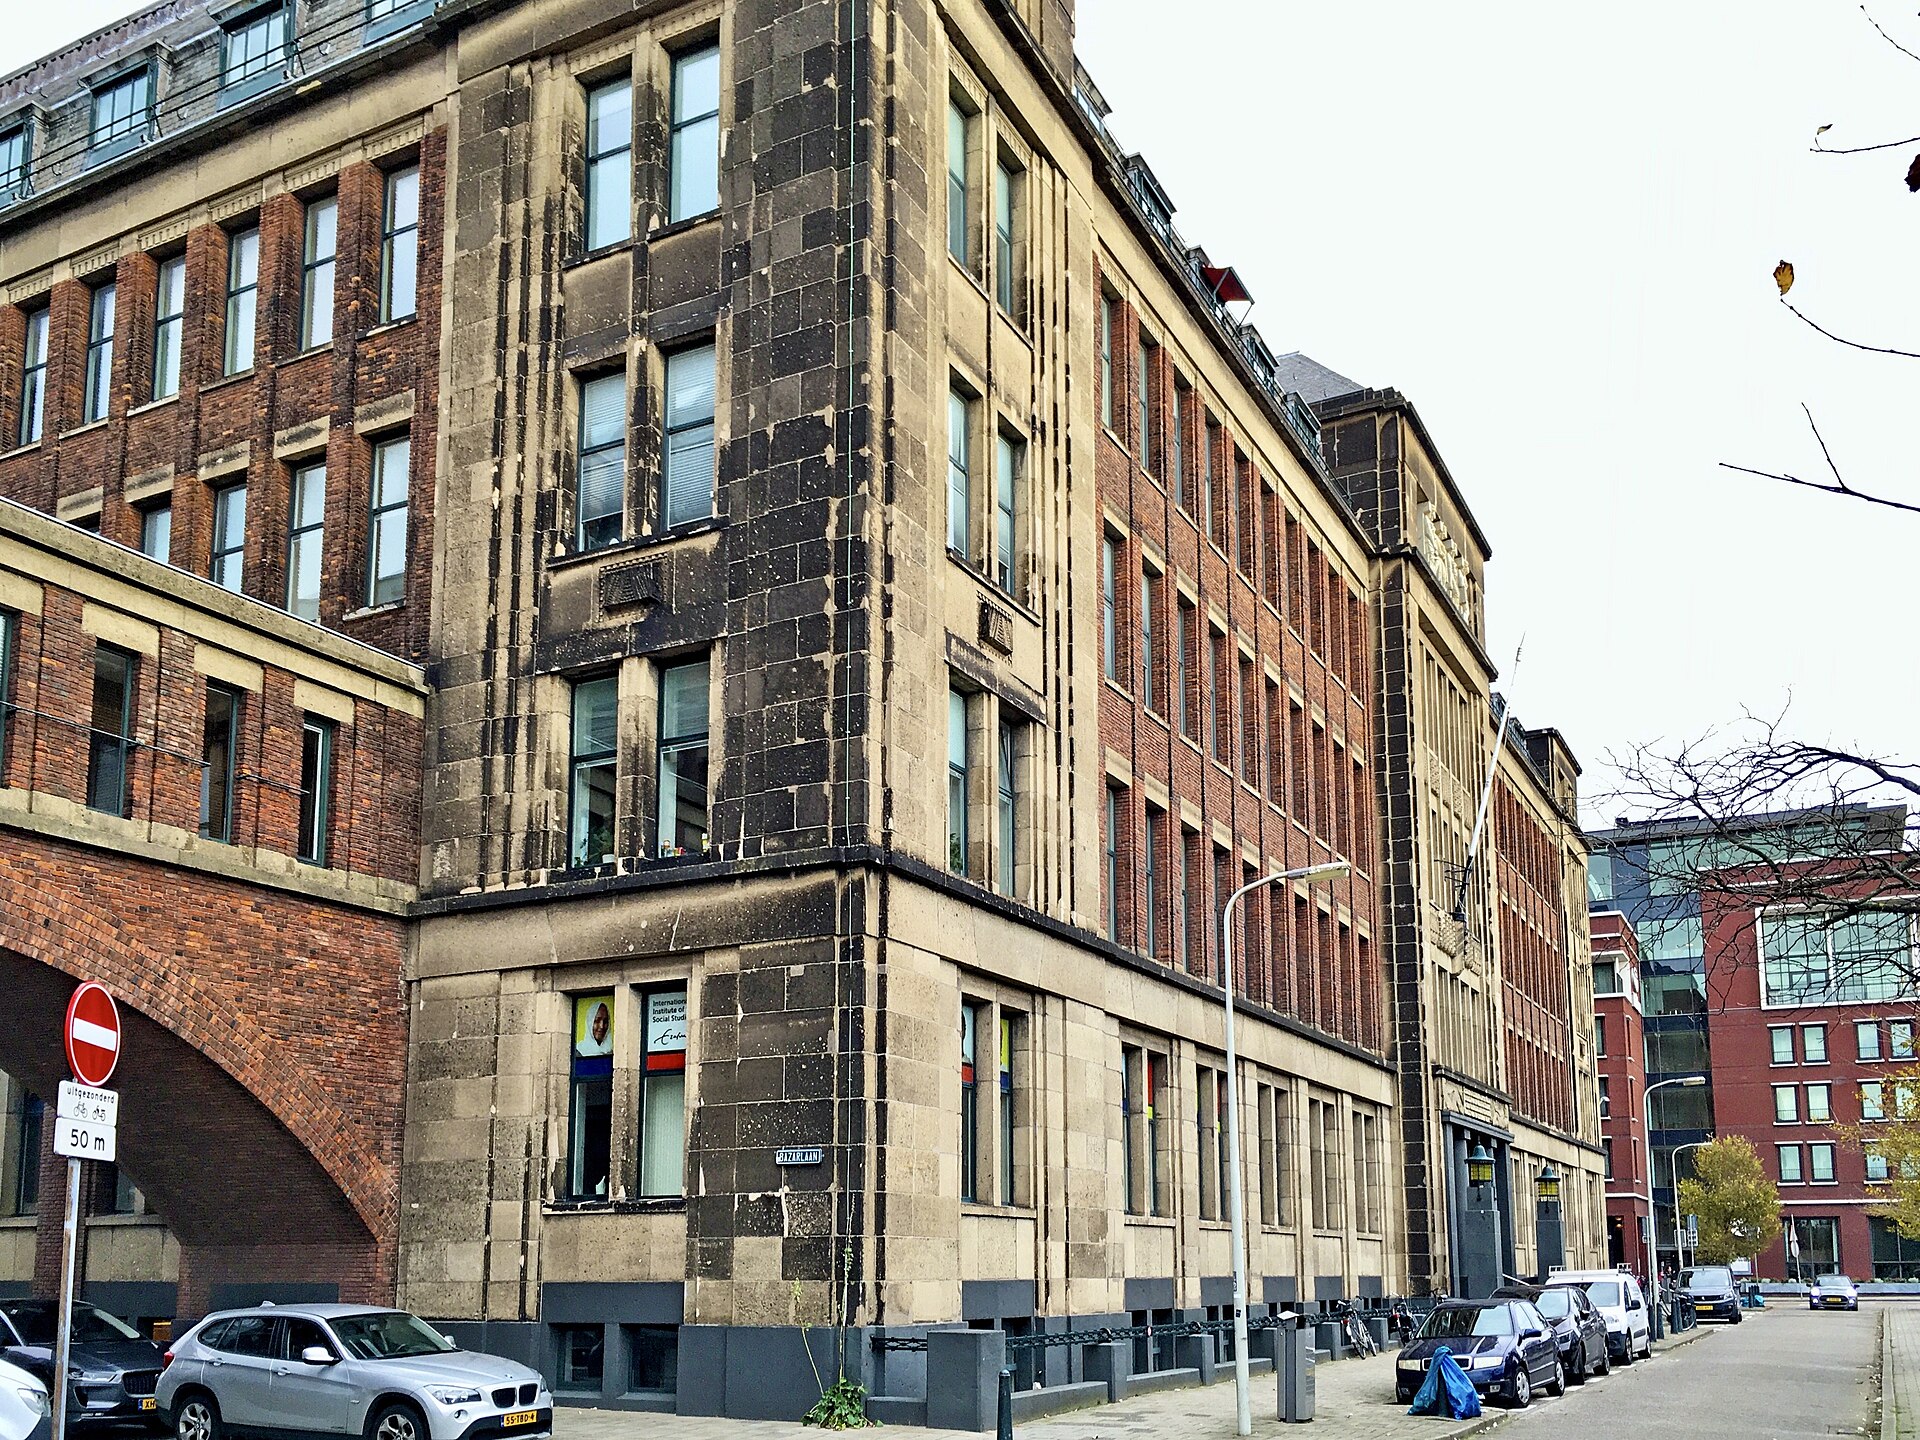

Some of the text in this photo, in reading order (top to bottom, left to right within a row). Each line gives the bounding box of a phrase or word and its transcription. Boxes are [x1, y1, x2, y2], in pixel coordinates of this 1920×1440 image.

[652, 999, 687, 1007] Internation
[652, 1007, 677, 1015] Institute
[652, 1015, 670, 1023] Social
[67, 1086, 115, 1104] uitgezonderd
[70, 1128, 105, 1151] 50 m
[779, 1151, 818, 1162] BAZARLAAN
